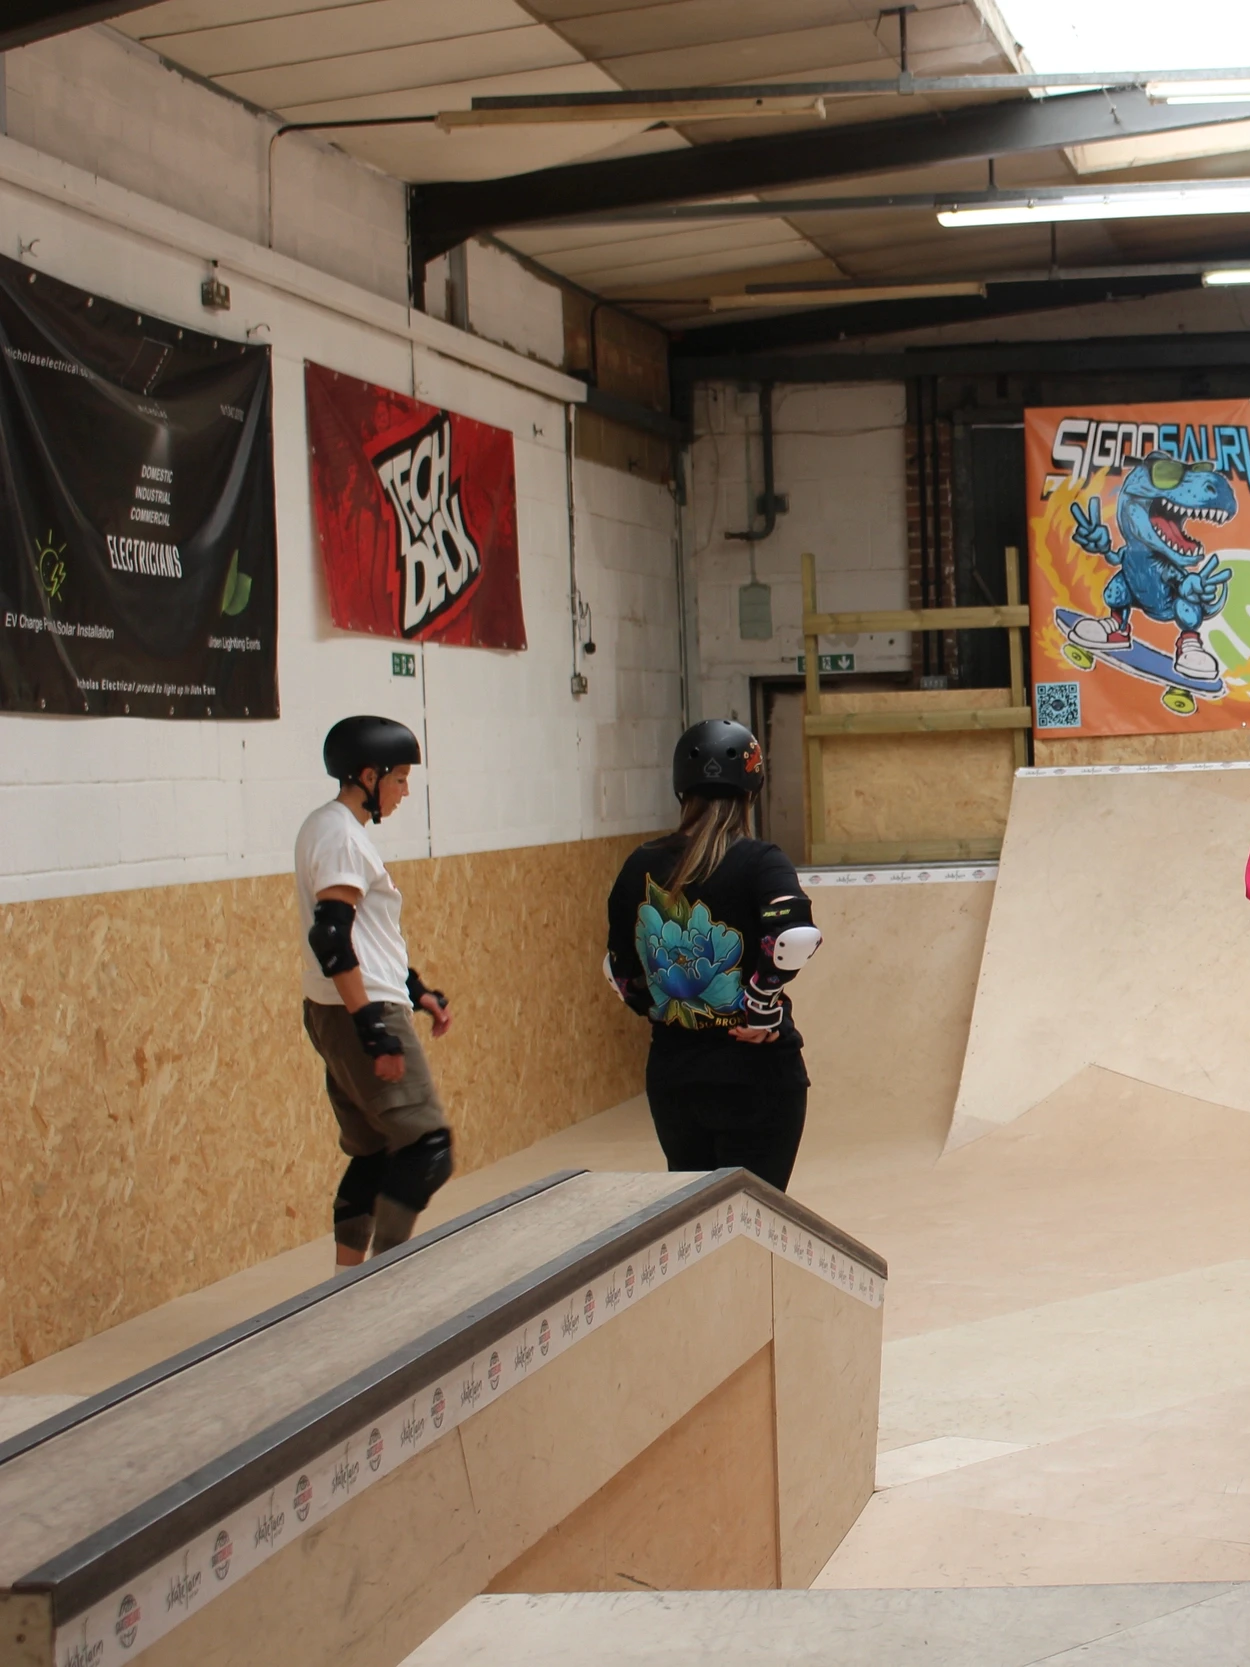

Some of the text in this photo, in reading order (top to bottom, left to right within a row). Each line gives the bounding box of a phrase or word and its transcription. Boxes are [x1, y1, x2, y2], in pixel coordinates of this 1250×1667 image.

[141, 464, 173, 484] DOMESTIC
[135, 486, 171, 505] INDUSTRIAL
[378, 420, 450, 557] TECH
[130, 507, 170, 527] COMMERCIAL
[106, 534, 182, 579] ELECTRICIANS
[404, 491, 480, 631] DECK
[5, 612, 17, 628] EV
[20, 614, 43, 634] Charge
[57, 621, 76, 637] Solar
[77, 622, 114, 640] Installation
[101, 678, 135, 693] Electrical
[136, 682, 156, 694] proud
